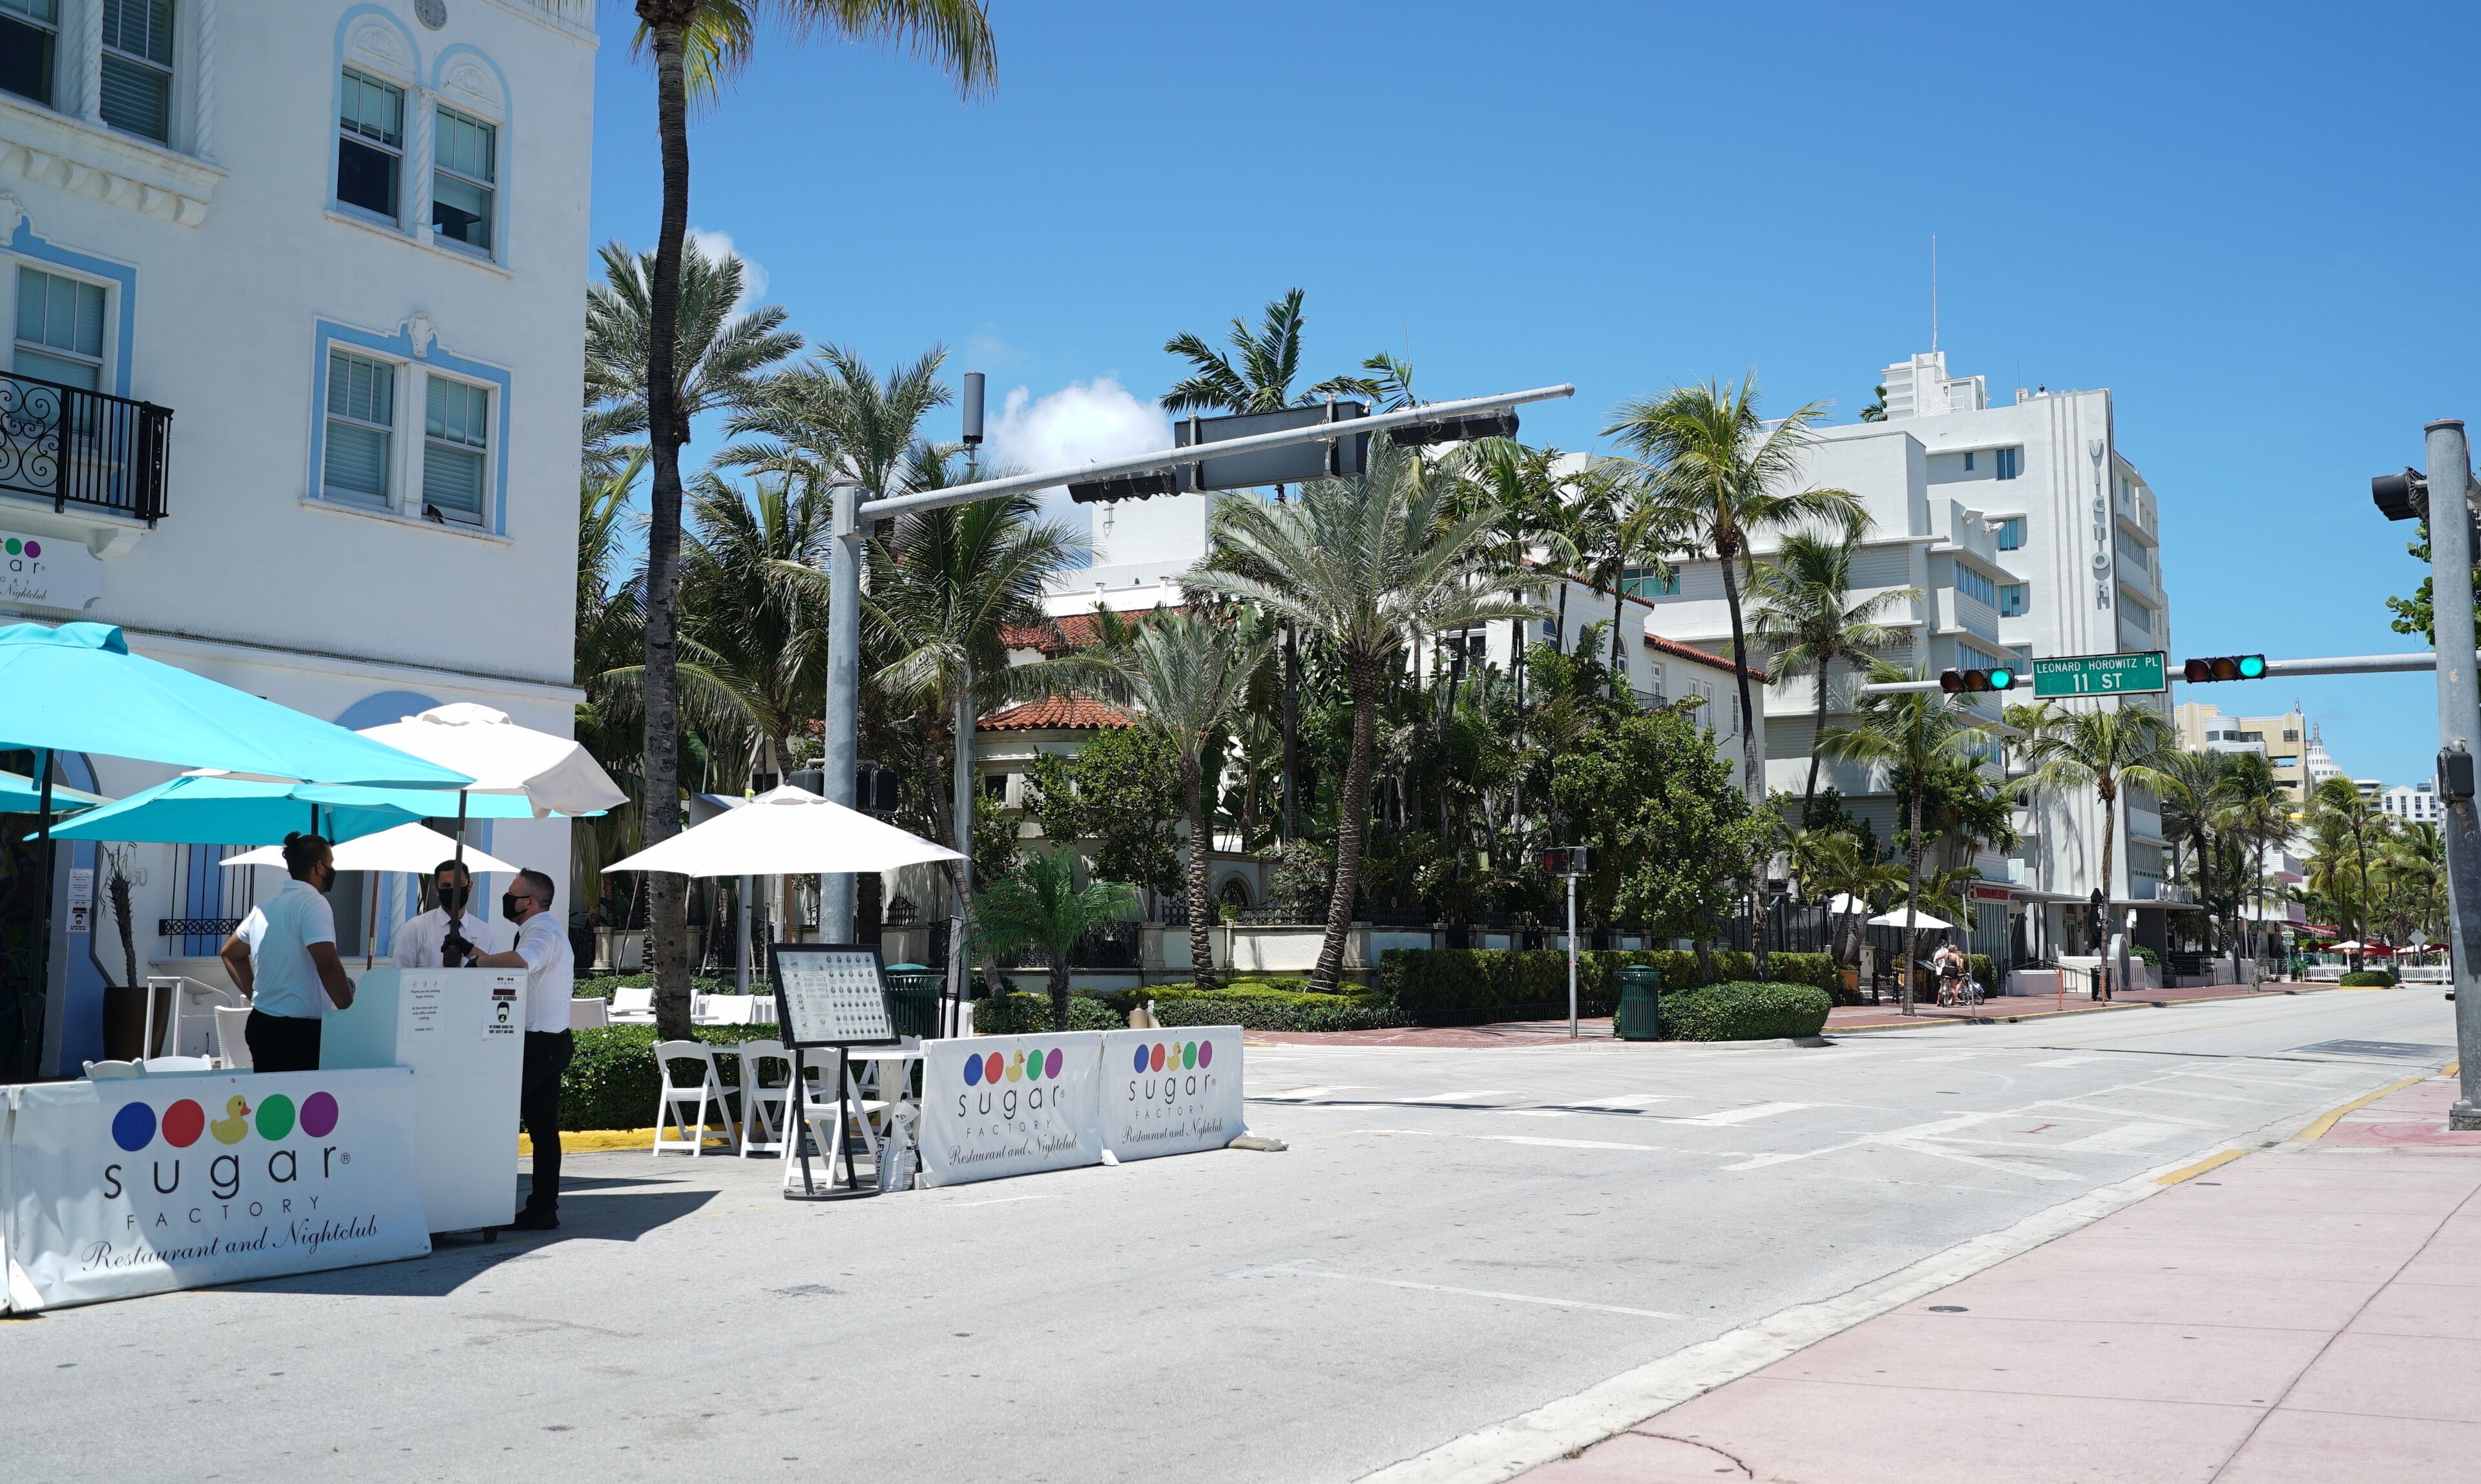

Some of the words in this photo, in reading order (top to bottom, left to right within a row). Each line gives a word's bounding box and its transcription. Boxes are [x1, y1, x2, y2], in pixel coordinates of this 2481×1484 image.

[2088, 439, 2109, 601] VICTOR
[2036, 662, 2081, 673] LEONARD
[2088, 658, 2137, 671] HOROWITZ
[2144, 657, 2159, 667] PL
[2072, 673, 2089, 693] 11
[2101, 673, 2122, 689] ST
[1135, 1104, 1204, 1120] FACTORY
[967, 1118, 1051, 1138] FACTORY
[1121, 1125, 1167, 1145] Restaurant
[1169, 1122, 1185, 1138] and
[1186, 1117, 1224, 1142] Nightclub
[949, 1144, 1007, 1165] Restaurant
[1007, 1138, 1029, 1158] and
[1029, 1133, 1078, 1160] Nightclub
[127, 1195, 319, 1231] FACTORY
[81, 1236, 222, 1272] Restaurant
[224, 1226, 269, 1253] and
[272, 1214, 379, 1254] Nightclub
